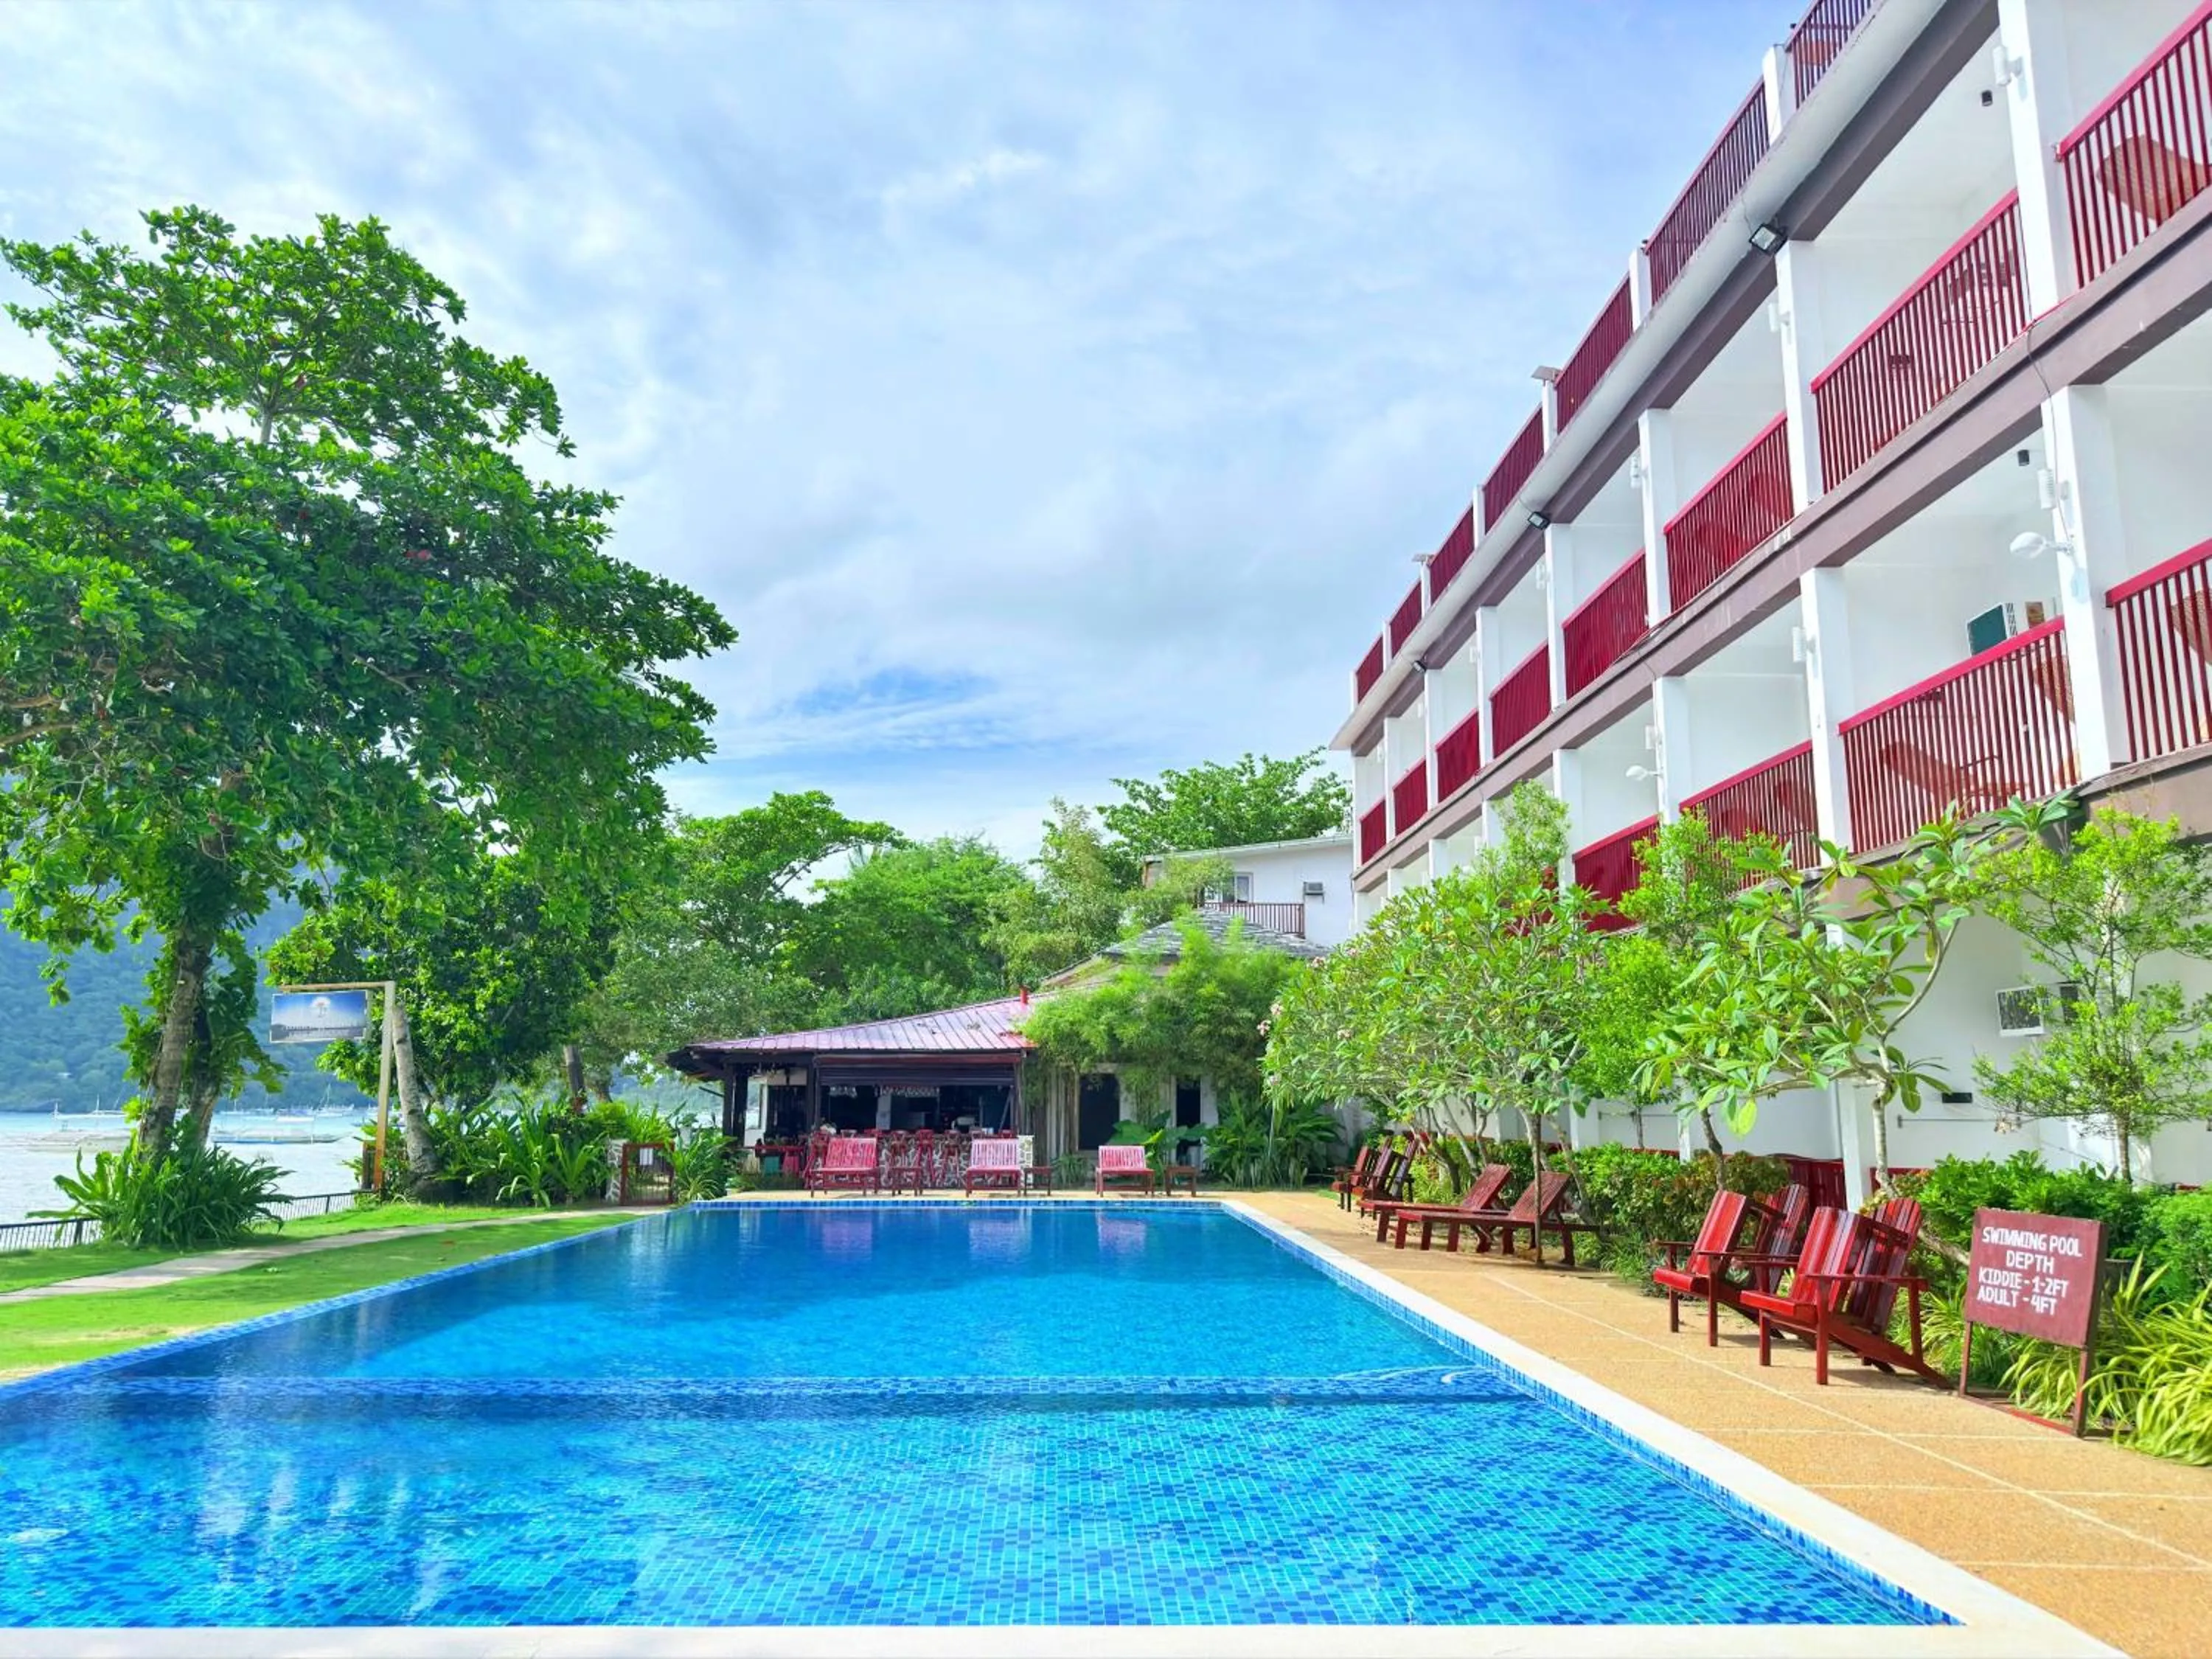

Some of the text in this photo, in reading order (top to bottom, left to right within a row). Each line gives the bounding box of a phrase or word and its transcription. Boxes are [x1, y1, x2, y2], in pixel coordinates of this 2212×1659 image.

[1982, 1227, 2082, 1256] SWIMMING POOL
[2006, 1250, 2054, 1274] DEPTH
[1977, 1285, 2019, 1307] ADULT
[2031, 1294, 2057, 1315] 4FT
